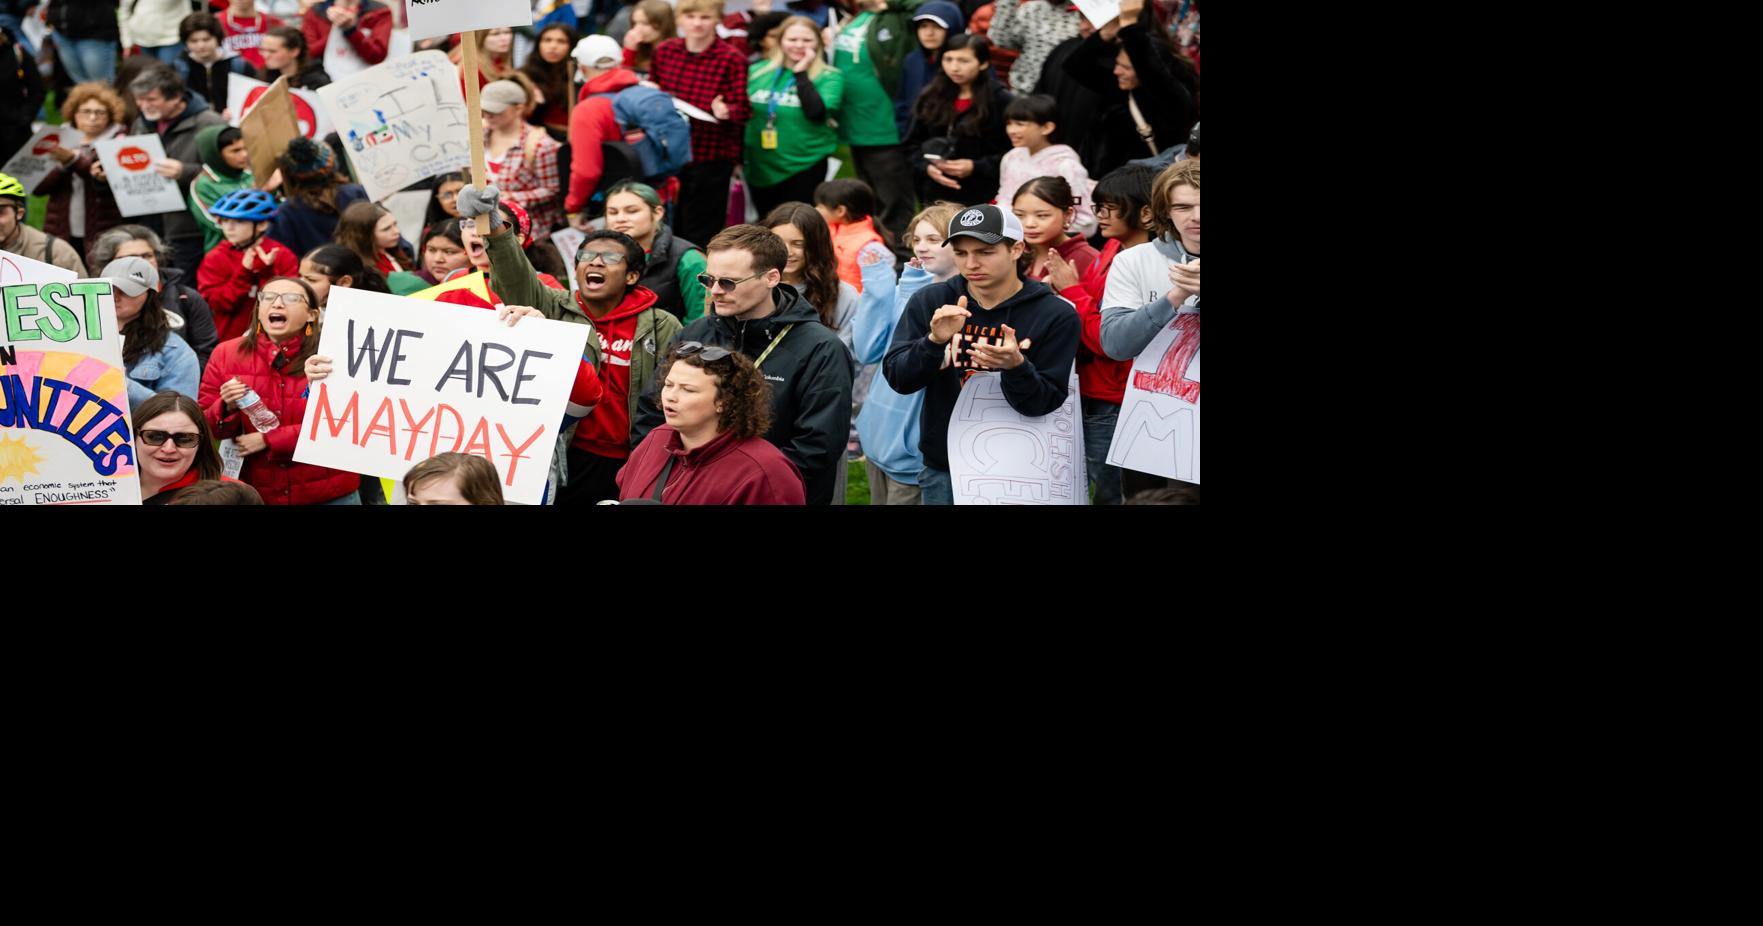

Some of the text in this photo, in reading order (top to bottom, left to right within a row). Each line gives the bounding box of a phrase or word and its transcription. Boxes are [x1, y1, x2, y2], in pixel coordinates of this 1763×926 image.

[347, 318, 554, 405] WE ARE
[309, 382, 545, 487] MAYDAY
[23, 483, 62, 491] economic
[68, 482, 95, 490] system
